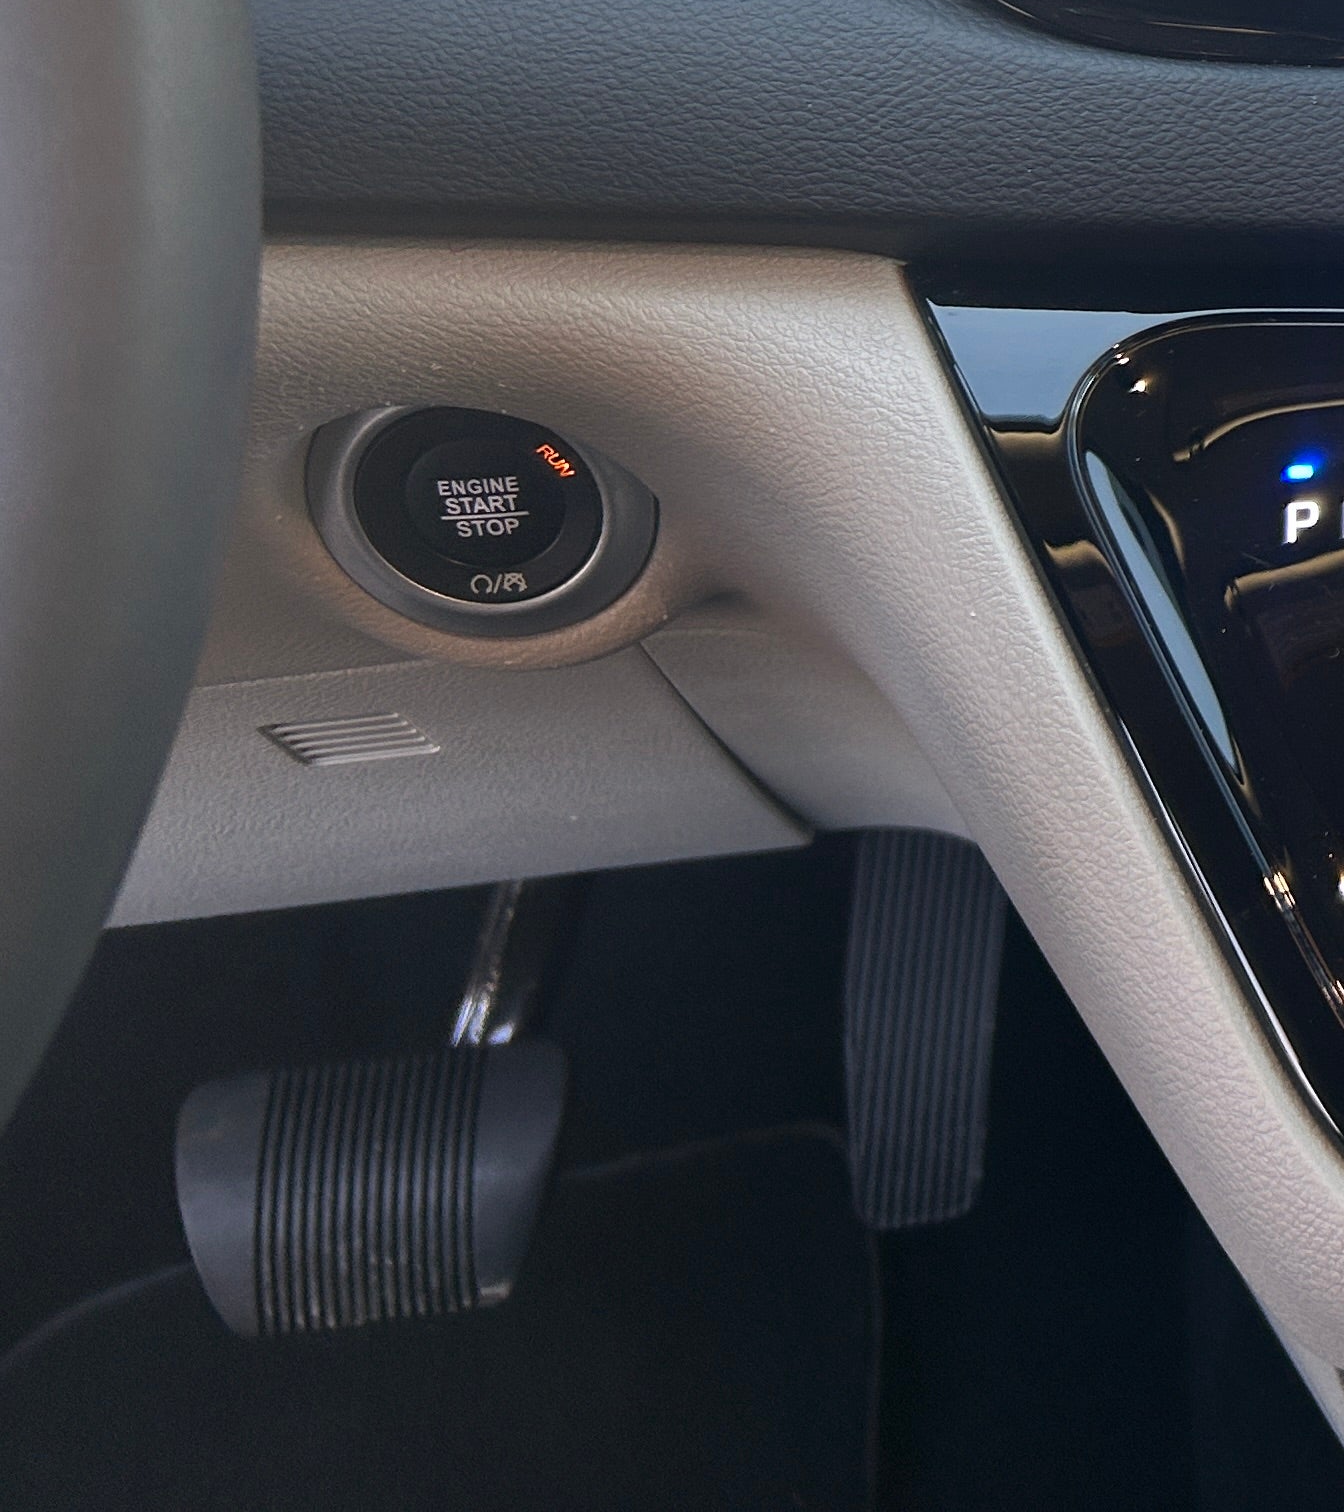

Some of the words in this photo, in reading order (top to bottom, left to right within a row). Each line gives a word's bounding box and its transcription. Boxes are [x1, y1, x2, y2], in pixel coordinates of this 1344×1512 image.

[536, 443, 575, 479] RUN
[437, 475, 520, 496] ENGINE
[445, 493, 518, 515] START
[457, 518, 520, 538] STOP
